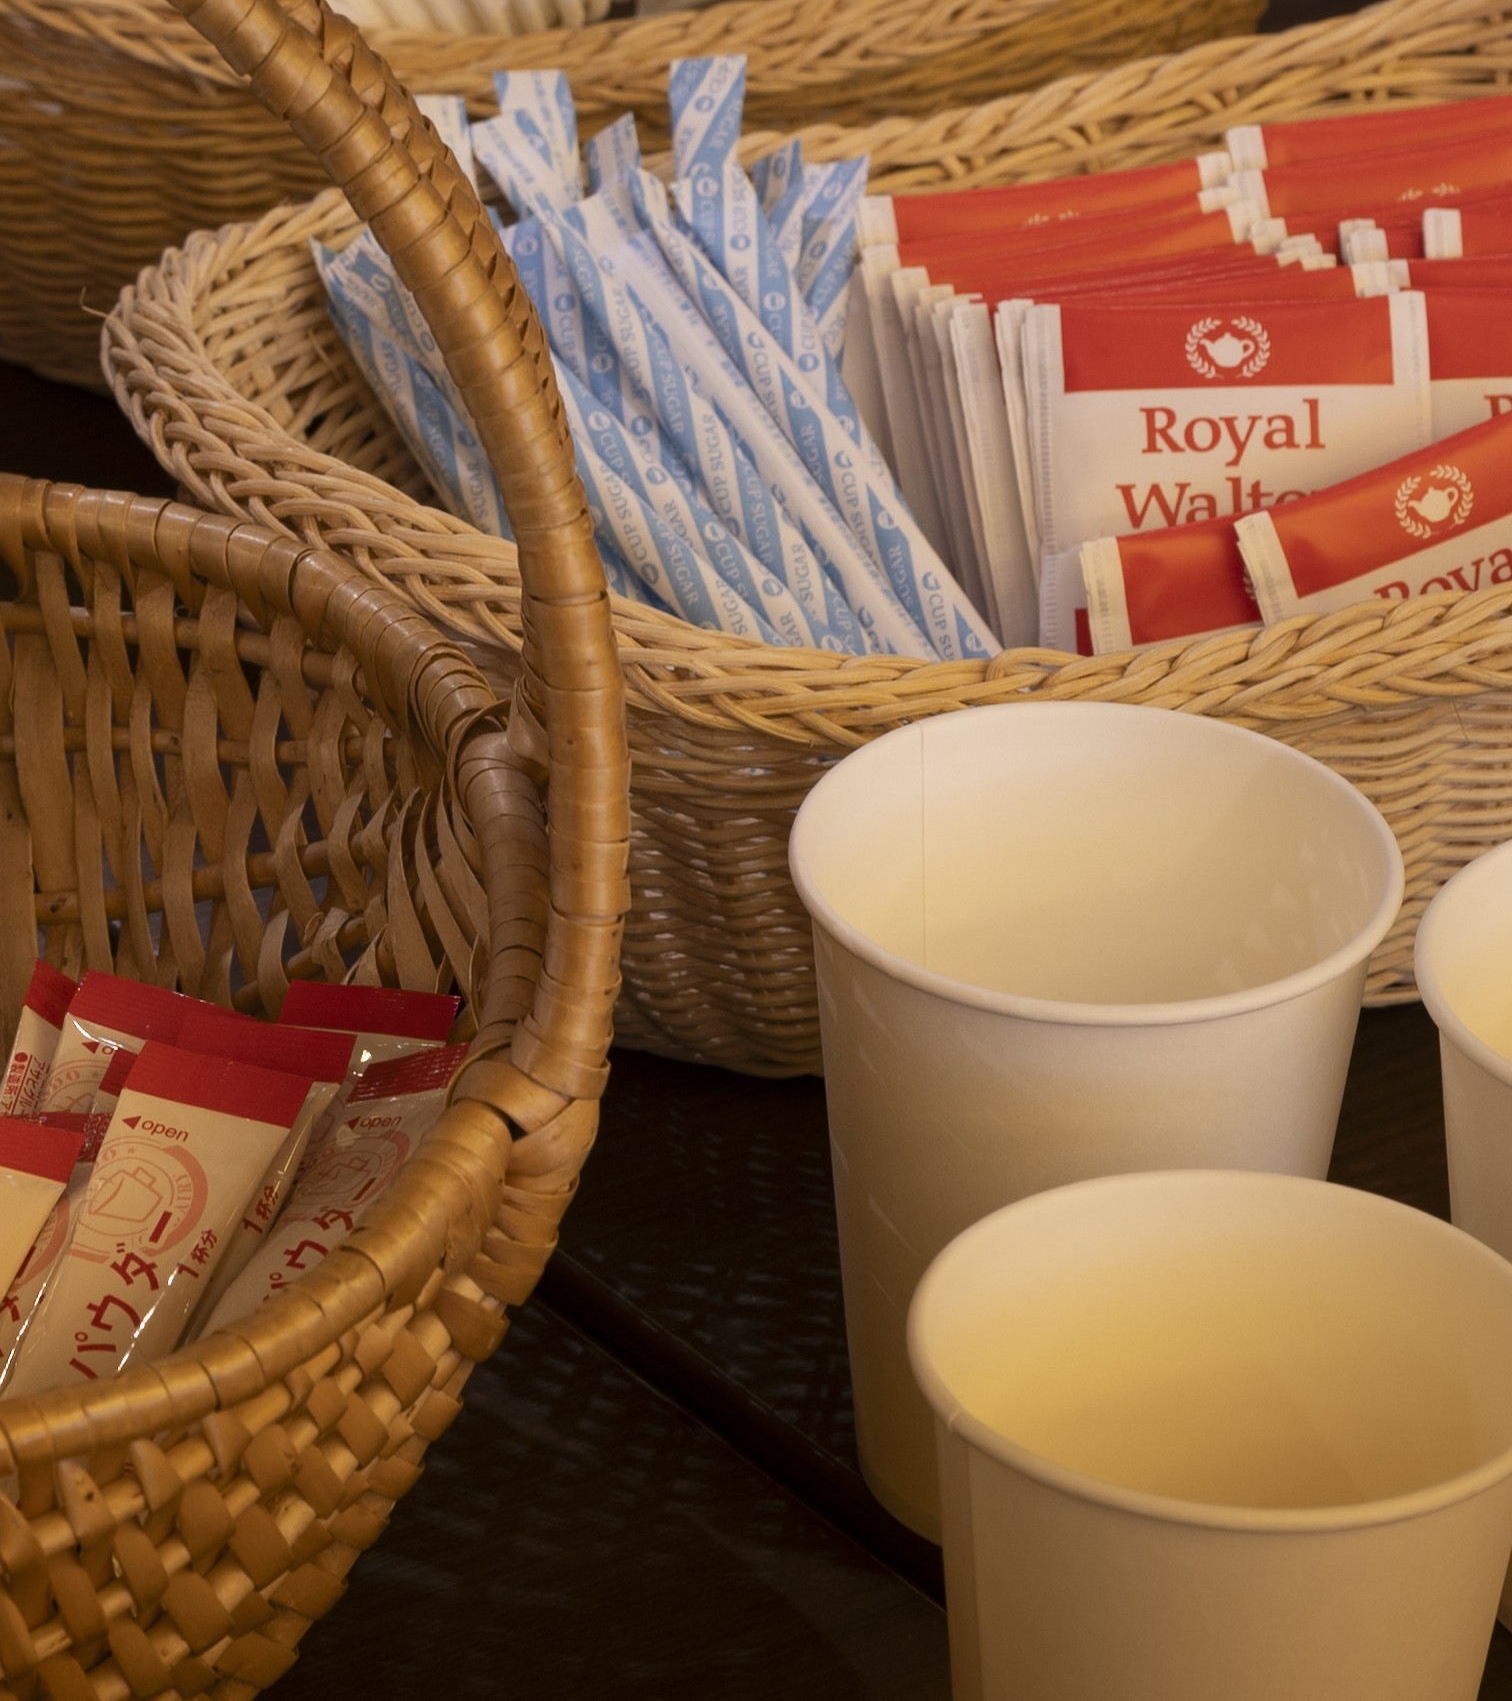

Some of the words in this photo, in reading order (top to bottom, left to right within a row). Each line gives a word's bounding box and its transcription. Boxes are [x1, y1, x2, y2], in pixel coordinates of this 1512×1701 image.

[1138, 398, 1326, 468] Royal
[141, 1119, 190, 1143] open
[359, 1115, 403, 1131] open
[68, 1210, 173, 1380] パウダー
